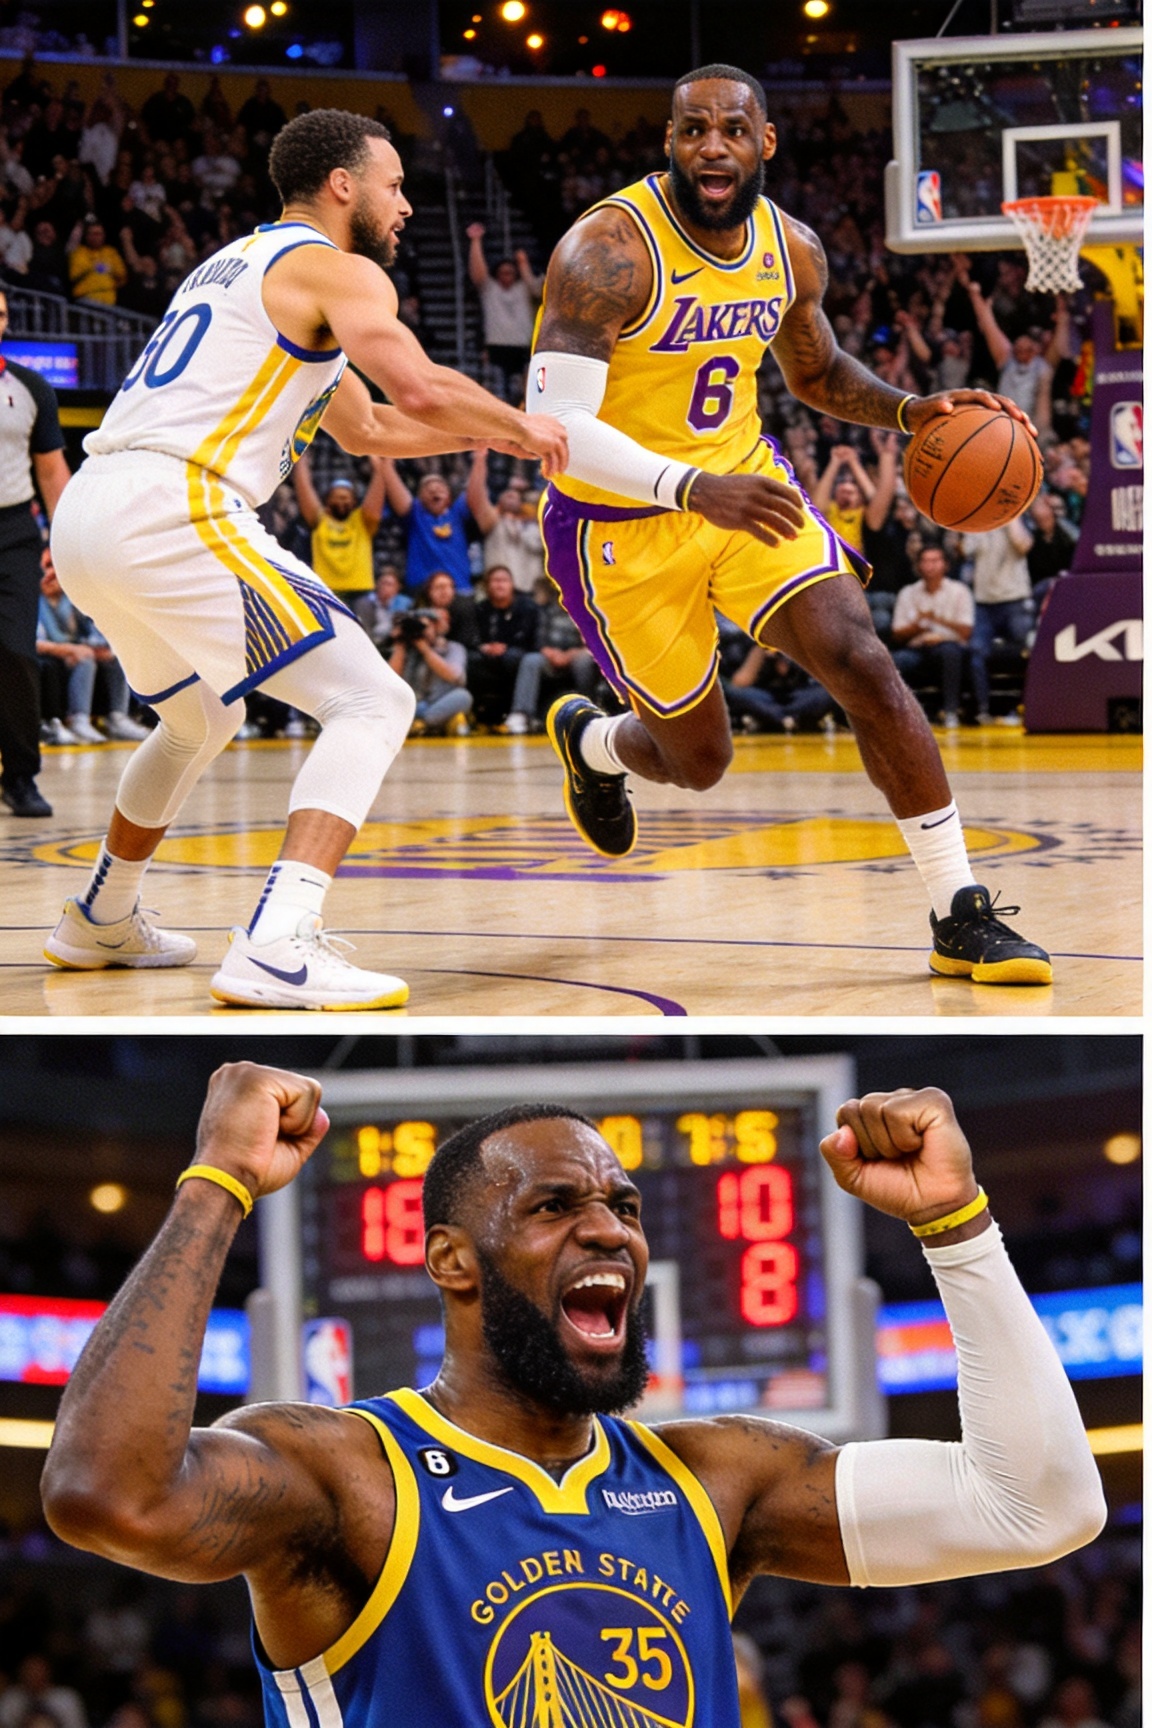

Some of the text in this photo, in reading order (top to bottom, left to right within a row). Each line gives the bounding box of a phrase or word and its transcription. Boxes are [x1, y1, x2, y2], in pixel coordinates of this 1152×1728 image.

[122, 303, 213, 389] 30
[649, 297, 784, 352] LAKERS
[687, 355, 741, 432] 6
[717, 1164, 794, 1242] 10
[740, 1241, 798, 1327] 8
[424, 1450, 452, 1476] 6
[470, 1549, 585, 1625] GOLDEN
[600, 1626, 673, 1691] 35
